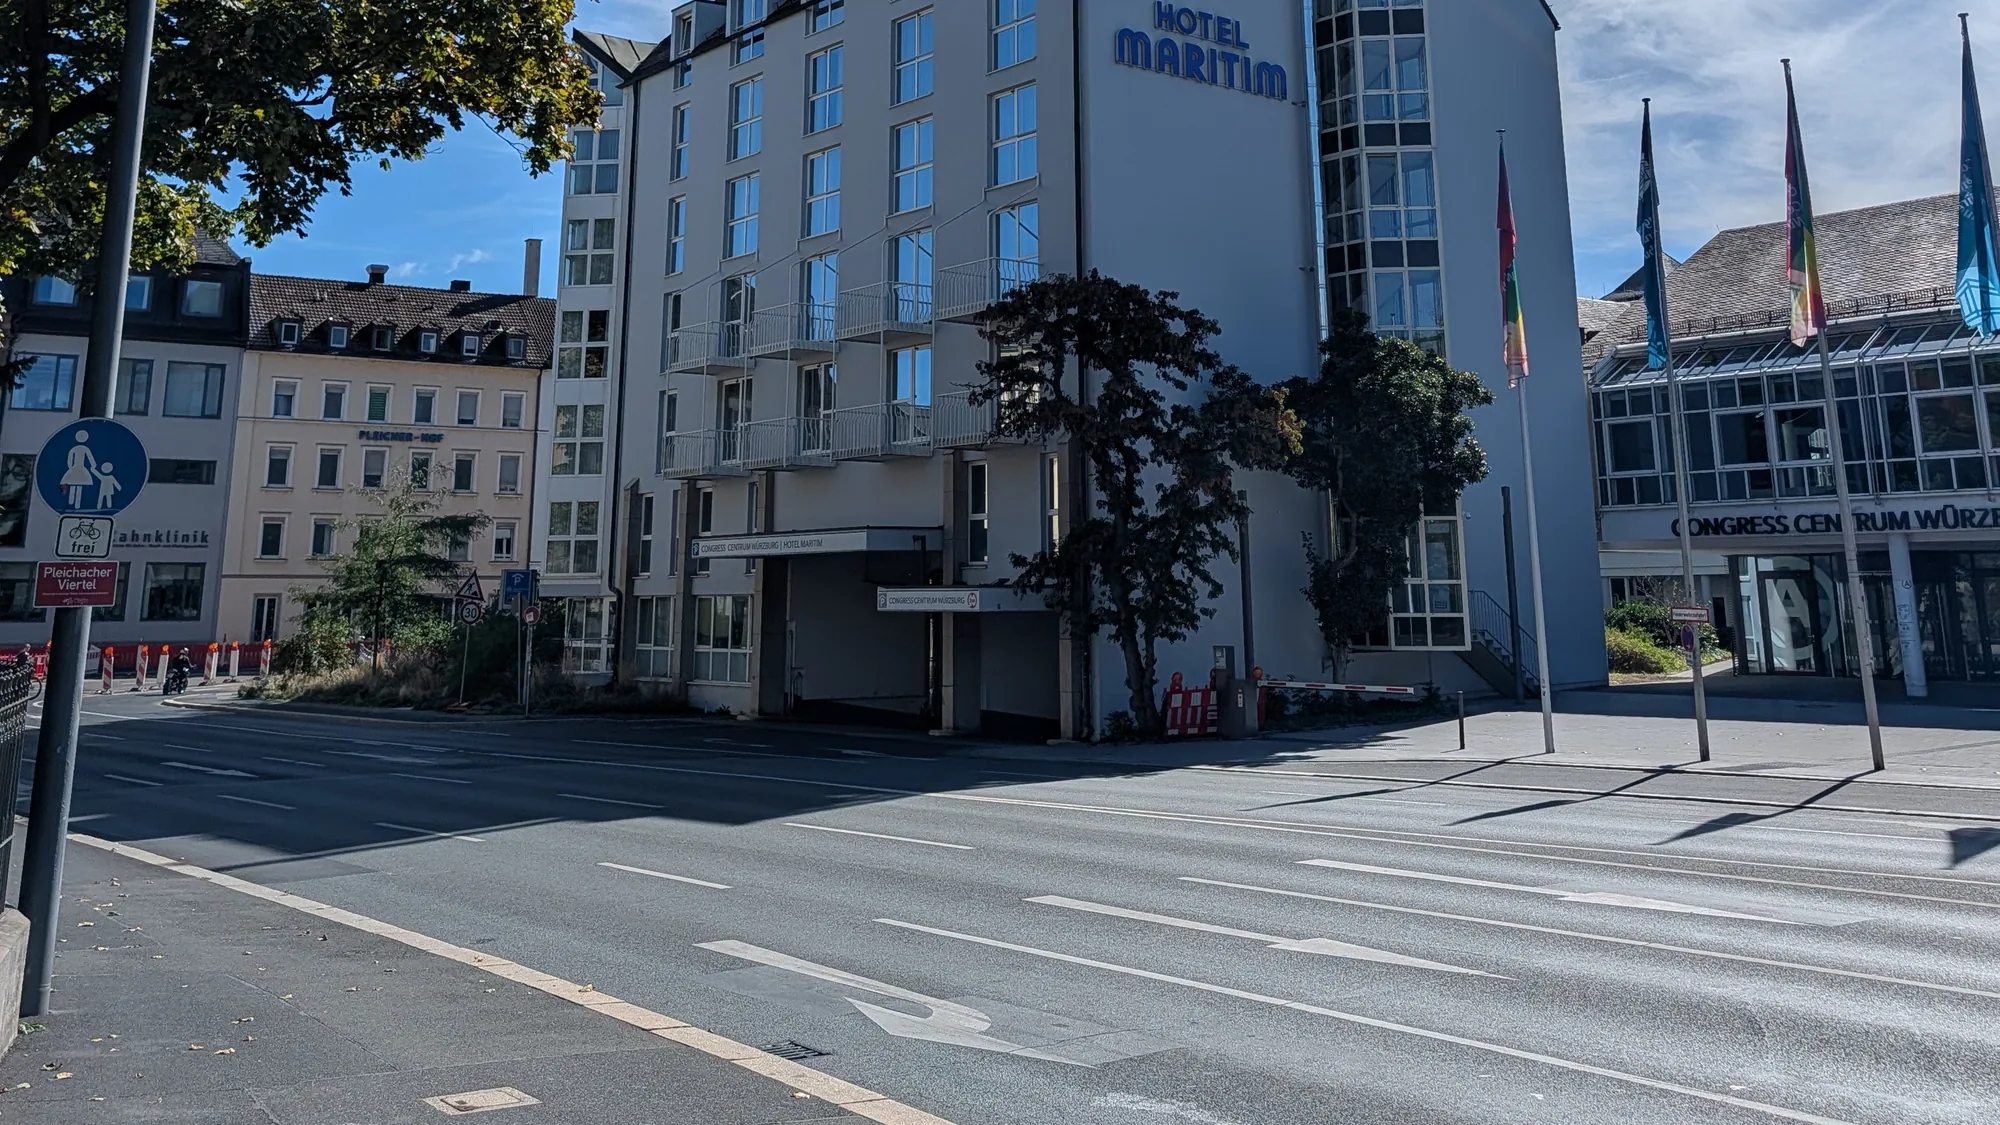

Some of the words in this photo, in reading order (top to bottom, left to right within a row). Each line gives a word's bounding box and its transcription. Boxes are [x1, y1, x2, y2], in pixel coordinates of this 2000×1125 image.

[1154, 1, 1250, 49] HOTEL
[1115, 28, 1288, 101] MARITIM
[1671, 514, 1790, 537] CONGRESS
[113, 529, 209, 543] ahnklinik
[71, 541, 96, 554] frei
[701, 543, 726, 553] CONGRESS
[728, 542, 751, 552] CENTRUM
[752, 540, 779, 551] WÜRZBURG
[783, 540, 800, 549] HOTEL
[800, 539, 824, 548] MARITIM
[43, 566, 113, 578] Pleichacher
[58, 578, 97, 590] Viertel
[888, 597, 914, 605] CONGRESS
[914, 596, 938, 604] CENTRUM
[464, 607, 477, 618] 30
